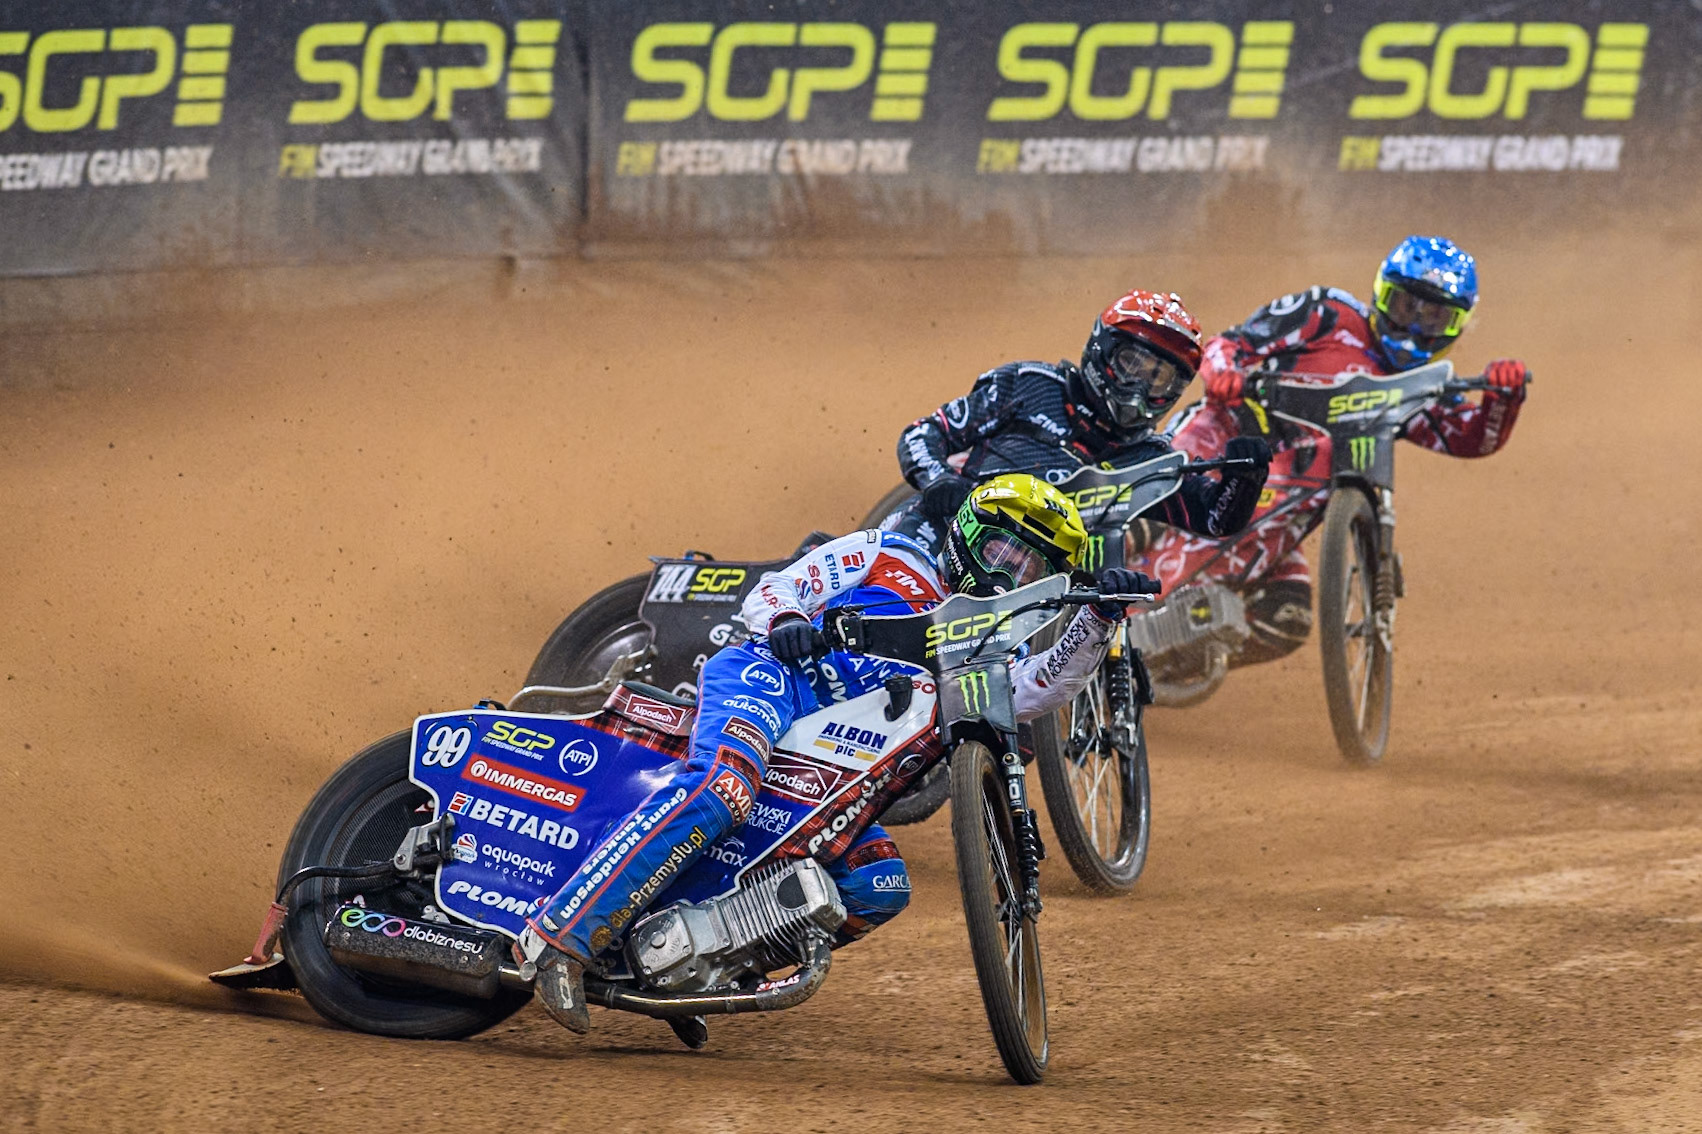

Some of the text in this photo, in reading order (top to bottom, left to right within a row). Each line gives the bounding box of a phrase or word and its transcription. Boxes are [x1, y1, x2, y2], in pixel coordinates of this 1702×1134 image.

[288, 20, 507, 124] SGP
[624, 22, 876, 122] SGP
[987, 22, 1235, 120] SGP
[1348, 22, 1591, 120] SGP
[88, 149, 160, 186] GRAND
[161, 146, 214, 182] PRIX
[317, 140, 425, 177] SPEEDWAY
[657, 139, 778, 175] SPEEDWAY
[776, 138, 857, 175] GRAND
[856, 138, 917, 174] PRIX
[1019, 136, 1139, 174] SPEEDWAY
[1137, 136, 1214, 173] GRAND
[1378, 134, 1495, 171] SPEEDWAY
[1493, 134, 1571, 172] GRAND
[1570, 134, 1624, 171] PRIX
[1064, 485, 1118, 508] GP
[690, 568, 746, 592] SGP
[925, 613, 996, 648] SGP
[936, 641, 971, 655] SPEEDWAY
[971, 636, 995, 648] GRD
[995, 633, 1012, 643] PRIX
[747, 669, 780, 689] ATPI
[632, 705, 673, 723] Alpodach
[421, 726, 472, 768] 99
[486, 720, 556, 750] SGP
[821, 721, 888, 750] ALBON
[564, 749, 593, 767] ATPI
[484, 767, 578, 807] IMMERGAS
[764, 768, 821, 796] lpodach
[468, 798, 580, 850] BETARD
[482, 844, 556, 878] aquapark
[560, 787, 688, 919] Grant Henderson
[582, 813, 646, 875] Tankers
[403, 926, 483, 954] dlabiznesu
